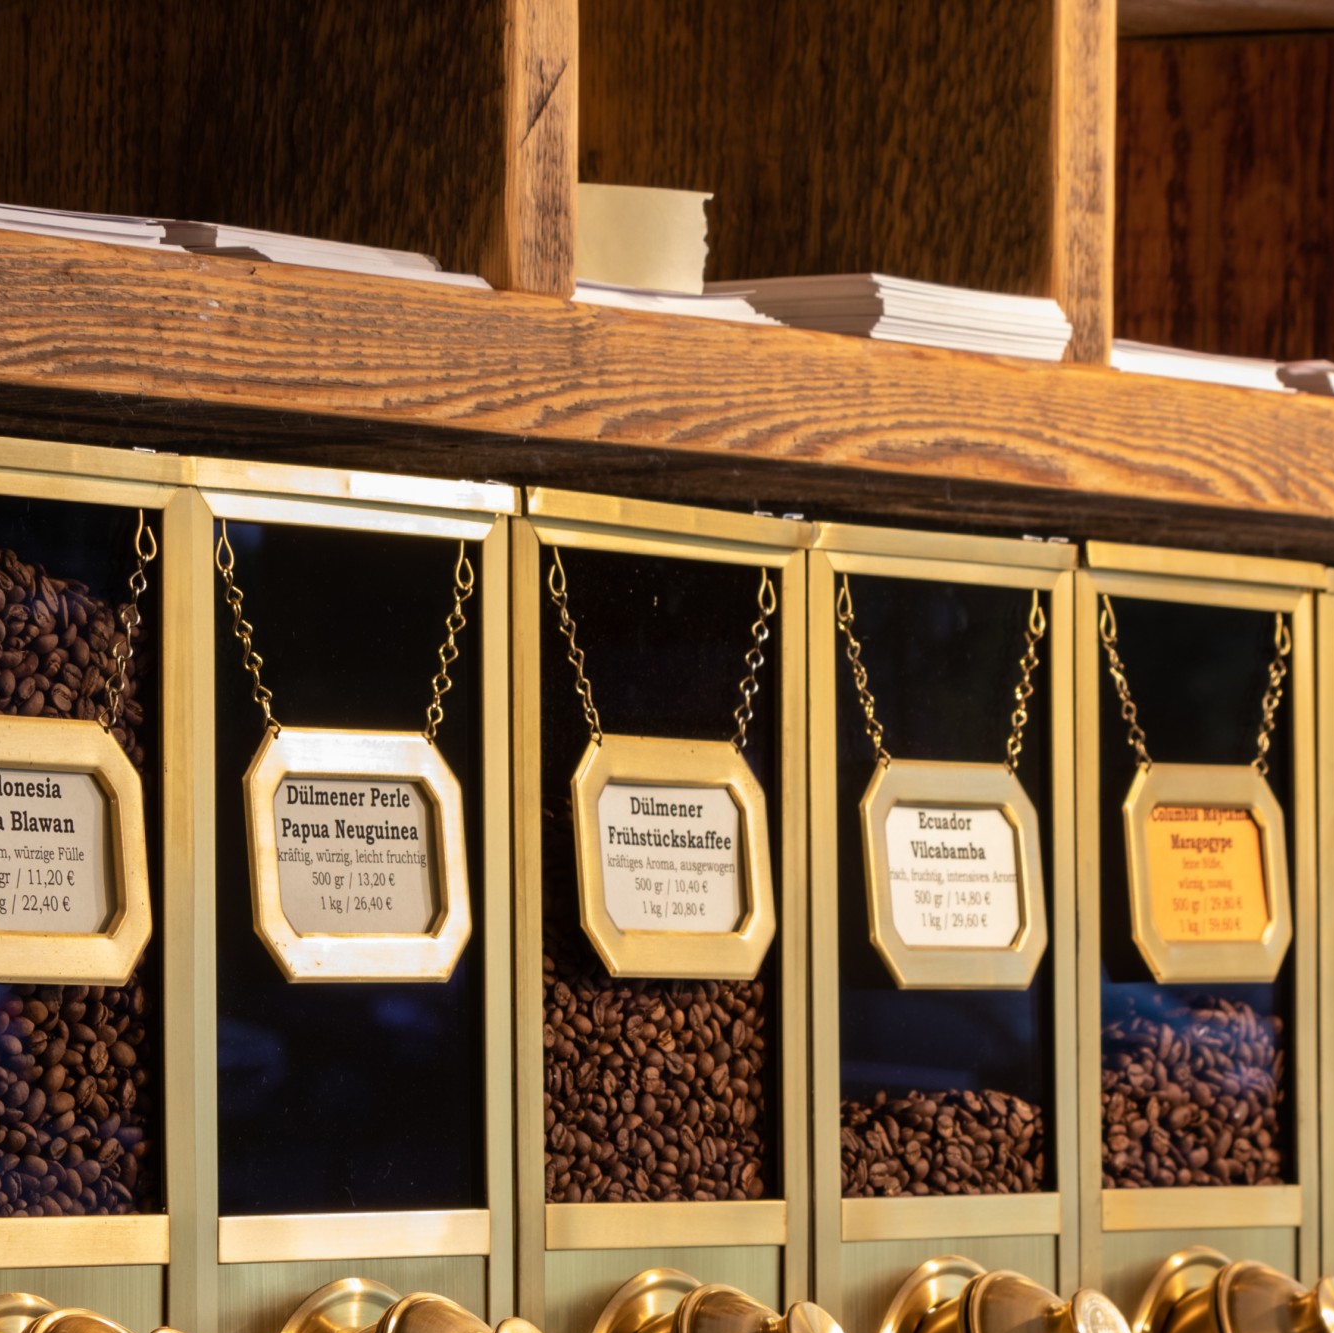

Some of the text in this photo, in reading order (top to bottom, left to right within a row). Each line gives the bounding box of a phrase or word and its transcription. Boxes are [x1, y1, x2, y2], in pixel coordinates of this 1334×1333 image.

[287, 785, 410, 807] Dülmener Perle
[630, 797, 703, 818] Dülmener
[10, 811, 75, 833] Blawan
[918, 812, 972, 830] Ecuador
[282, 818, 418, 845] Papua Neuguinea
[608, 826, 731, 850] Frühstückskaffee
[911, 841, 986, 860] Vilcabamba
[1171, 834, 1232, 853] Maragogype
[14, 846, 55, 863] würzige
[58, 847, 84, 861] Fülle
[277, 848, 426, 867] kräftig, würzig, leicht fruchtig
[607, 854, 735, 876] kräftiges Aroma, ausgewogen
[17, 868, 21, 888] /
[28, 869, 63, 887] 11,20
[67, 871, 75, 886] €
[312, 872, 395, 889] 500 gr / 13,20 €
[889, 869, 909, 882] risch,
[635, 878, 651, 891] 500
[655, 882, 663, 895] gr
[675, 880, 700, 894] 10,40
[702, 881, 708, 893] €
[12, 894, 16, 914] /
[22, 895, 59, 914] 22,40
[63, 896, 70, 911] €
[321, 896, 393, 913] 1 kg / 26,40 €
[915, 890, 931, 904] 500
[934, 894, 943, 908] gr
[984, 892, 991, 905] €
[650, 901, 662, 917] kg
[672, 902, 697, 917] 20,80
[699, 903, 705, 916] €
[930, 913, 941, 930] kg
[981, 914, 987, 927] €
